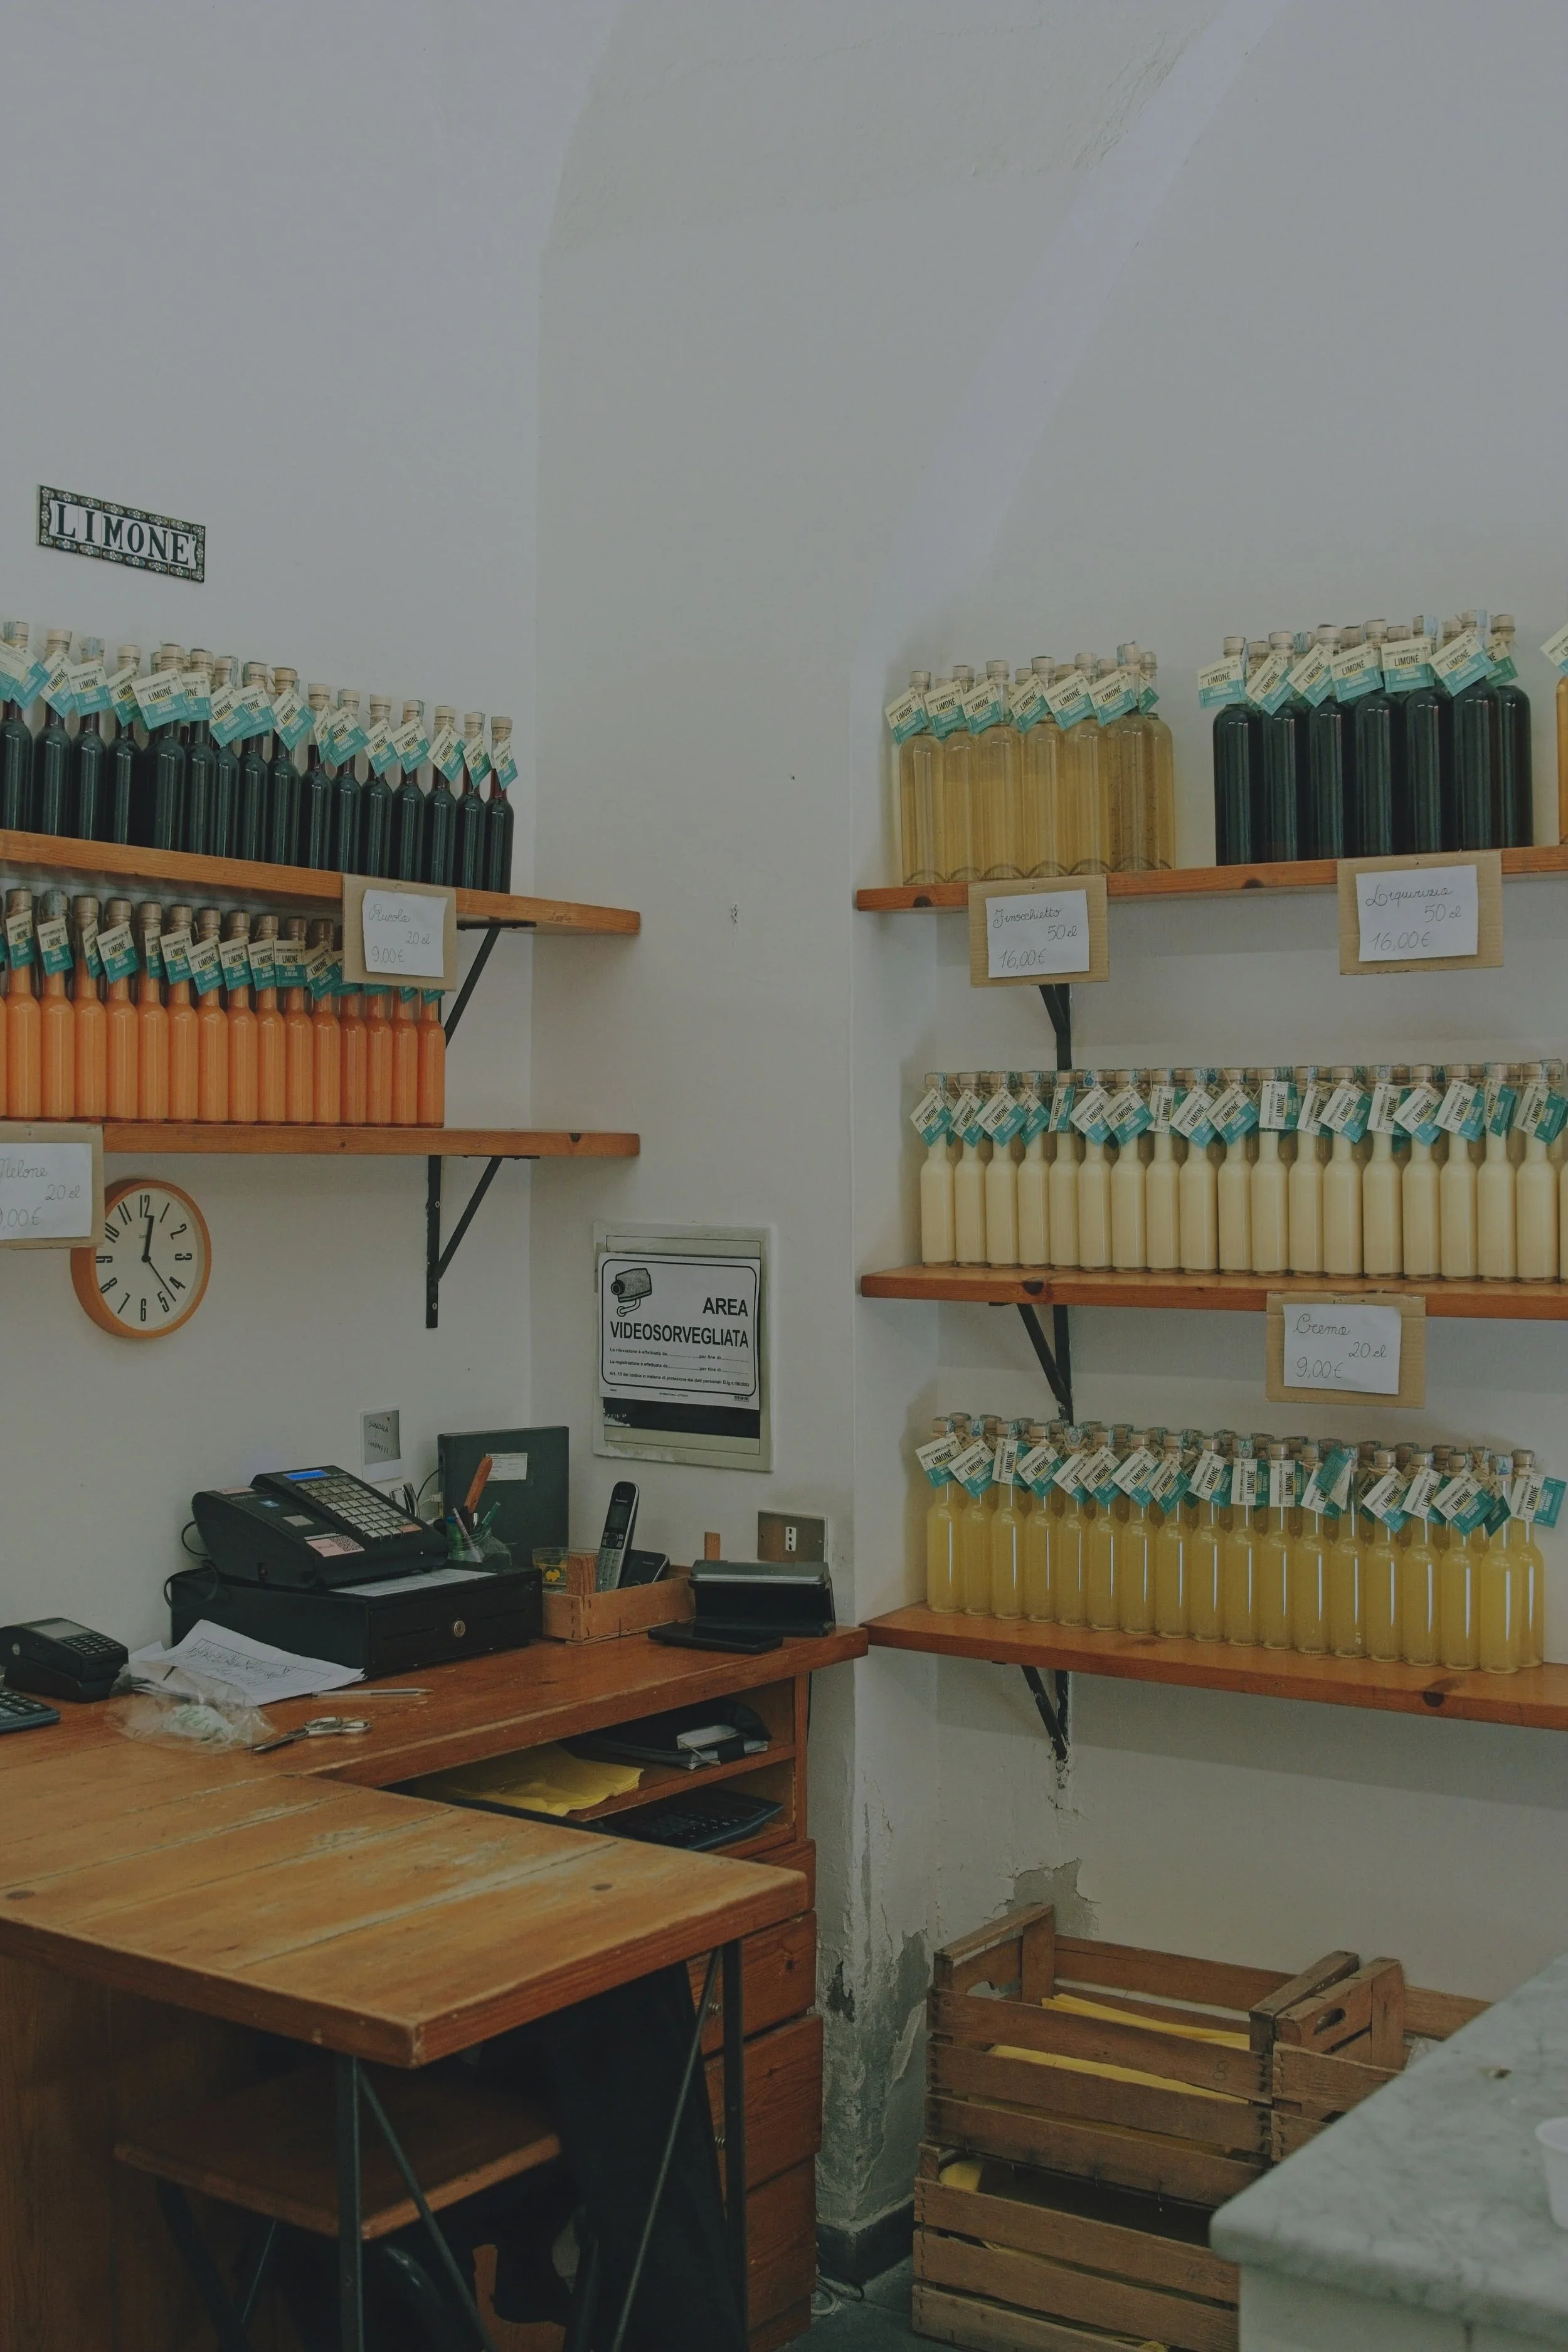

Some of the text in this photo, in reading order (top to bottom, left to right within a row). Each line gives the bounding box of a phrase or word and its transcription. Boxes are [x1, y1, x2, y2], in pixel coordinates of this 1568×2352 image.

[56, 503, 189, 565] LIMONE
[368, 903, 411, 923] Rucola
[1424, 903, 1461, 923] 50 cl
[405, 931, 431, 945] 20 cl
[1047, 924, 1077, 941] 50 cl
[45, 1184, 65, 1200] 20
[140, 1194, 153, 1218] 12
[174, 1253, 192, 1261] 3
[140, 1298, 146, 1322] 6
[702, 1297, 748, 1317] AREA
[610, 1321, 749, 1348] VIDEOSORVEGLIATA
[1293, 1313, 1351, 1336] Crema
[1348, 1342, 1387, 1358] 20 cl
